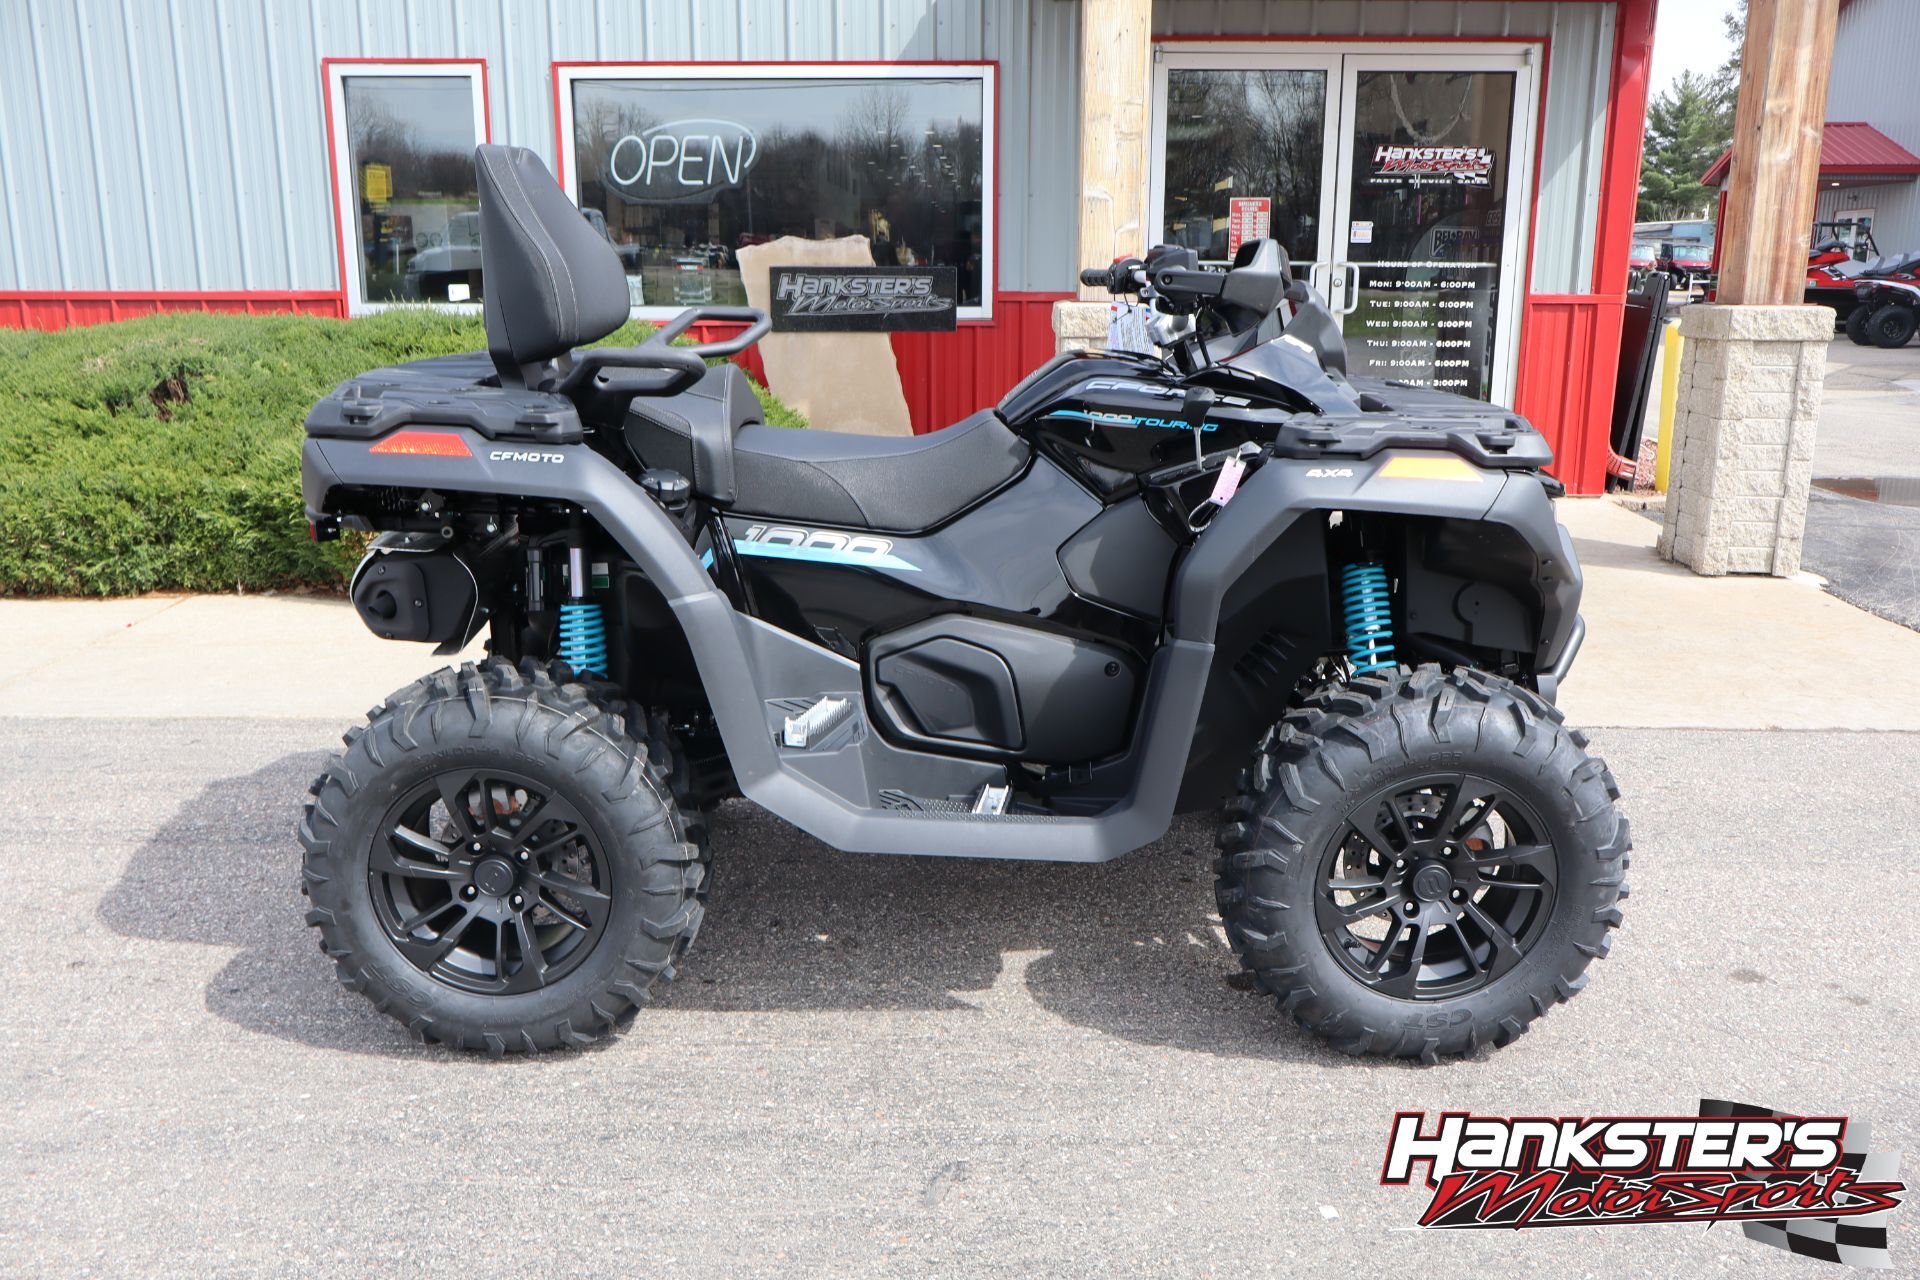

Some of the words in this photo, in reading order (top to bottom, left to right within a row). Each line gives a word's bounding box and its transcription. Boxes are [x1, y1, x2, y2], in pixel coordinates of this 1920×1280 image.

[610, 135, 744, 186] OPEN
[1377, 260, 1408, 268] HOURS
[1426, 261, 1477, 269] OPERATION
[1441, 281, 1476, 289] 6:00PM
[1394, 300, 1429, 308] 9:00AM
[1439, 301, 1474, 309] 6:00PM
[1392, 320, 1428, 328] 9:00AM
[1436, 340, 1471, 348] 6:00PM
[1434, 360, 1470, 368] 6:00PM
[1433, 379, 1468, 387] 3:00PM
[490, 451, 565, 464] CFMOTO
[1305, 468, 1354, 478] 4X4
[745, 524, 894, 561] 1000
